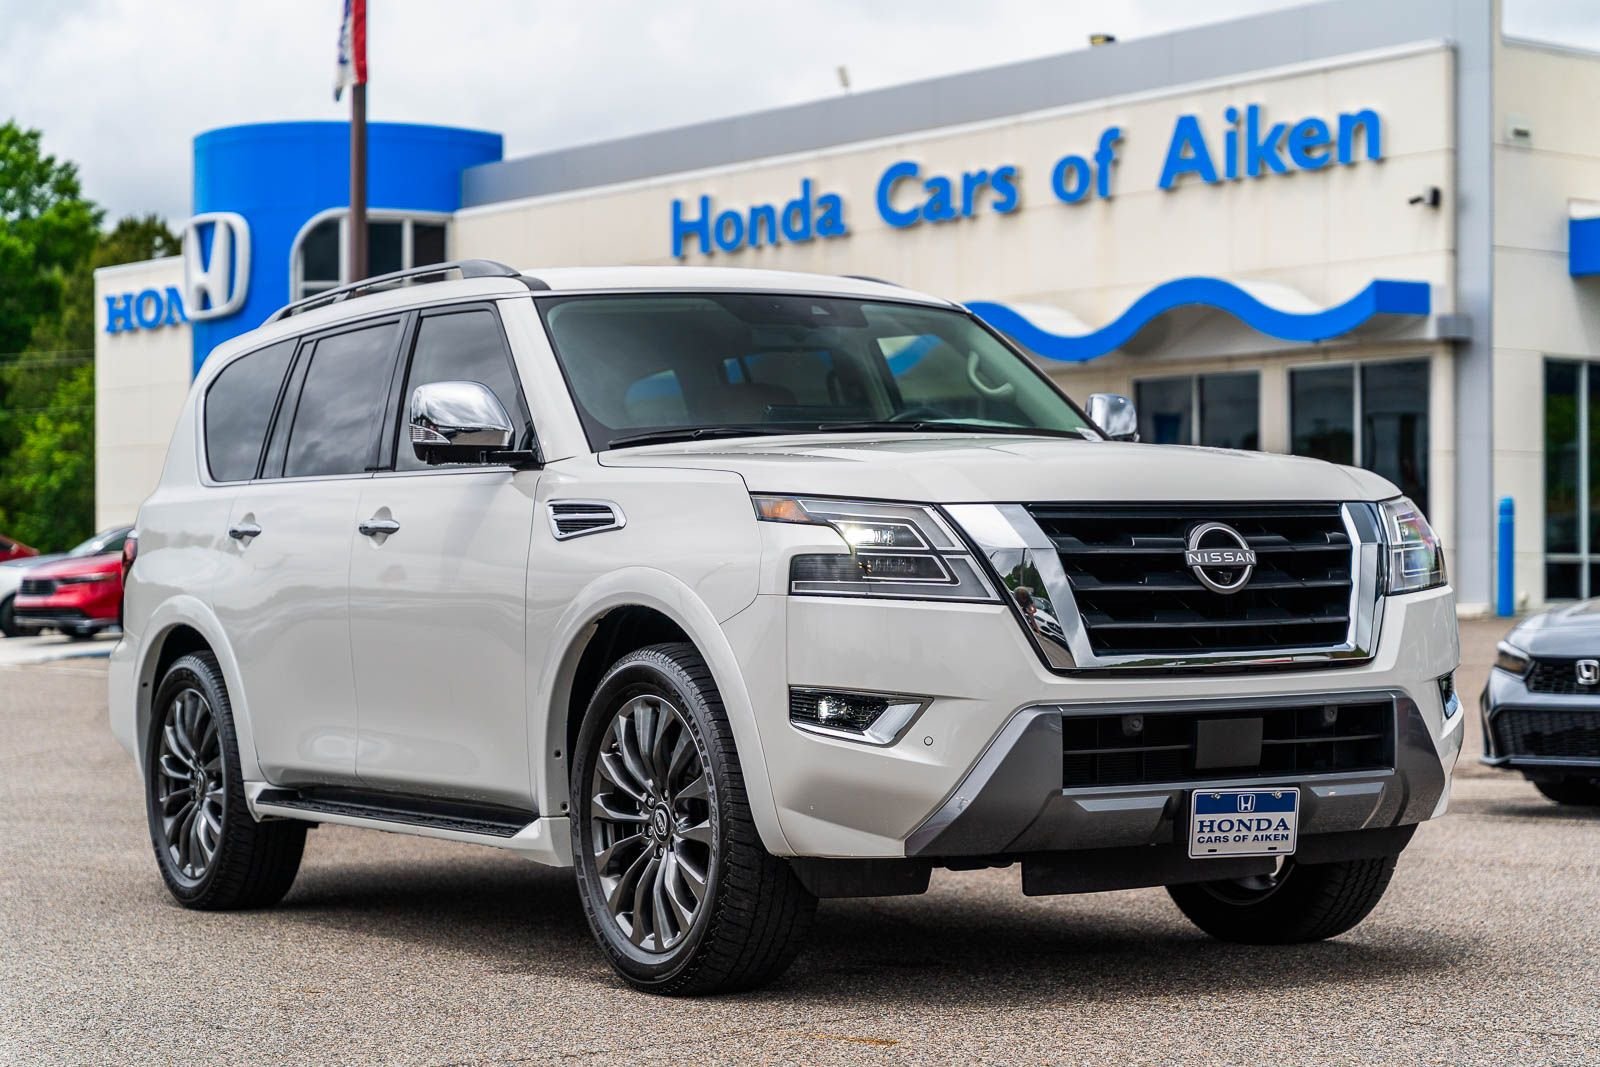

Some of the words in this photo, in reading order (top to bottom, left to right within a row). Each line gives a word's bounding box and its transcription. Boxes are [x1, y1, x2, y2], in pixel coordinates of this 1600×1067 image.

[671, 178, 848, 259] Honda
[875, 160, 1020, 229] Cars
[1050, 126, 1123, 204] of
[1157, 103, 1383, 190] Aiken
[1188, 552, 1255, 563] NISSAN
[1197, 818, 1290, 834] HONDA
[1197, 835, 1230, 844] CARS
[1233, 834, 1249, 843] OF
[1252, 833, 1290, 842] AIKEN
